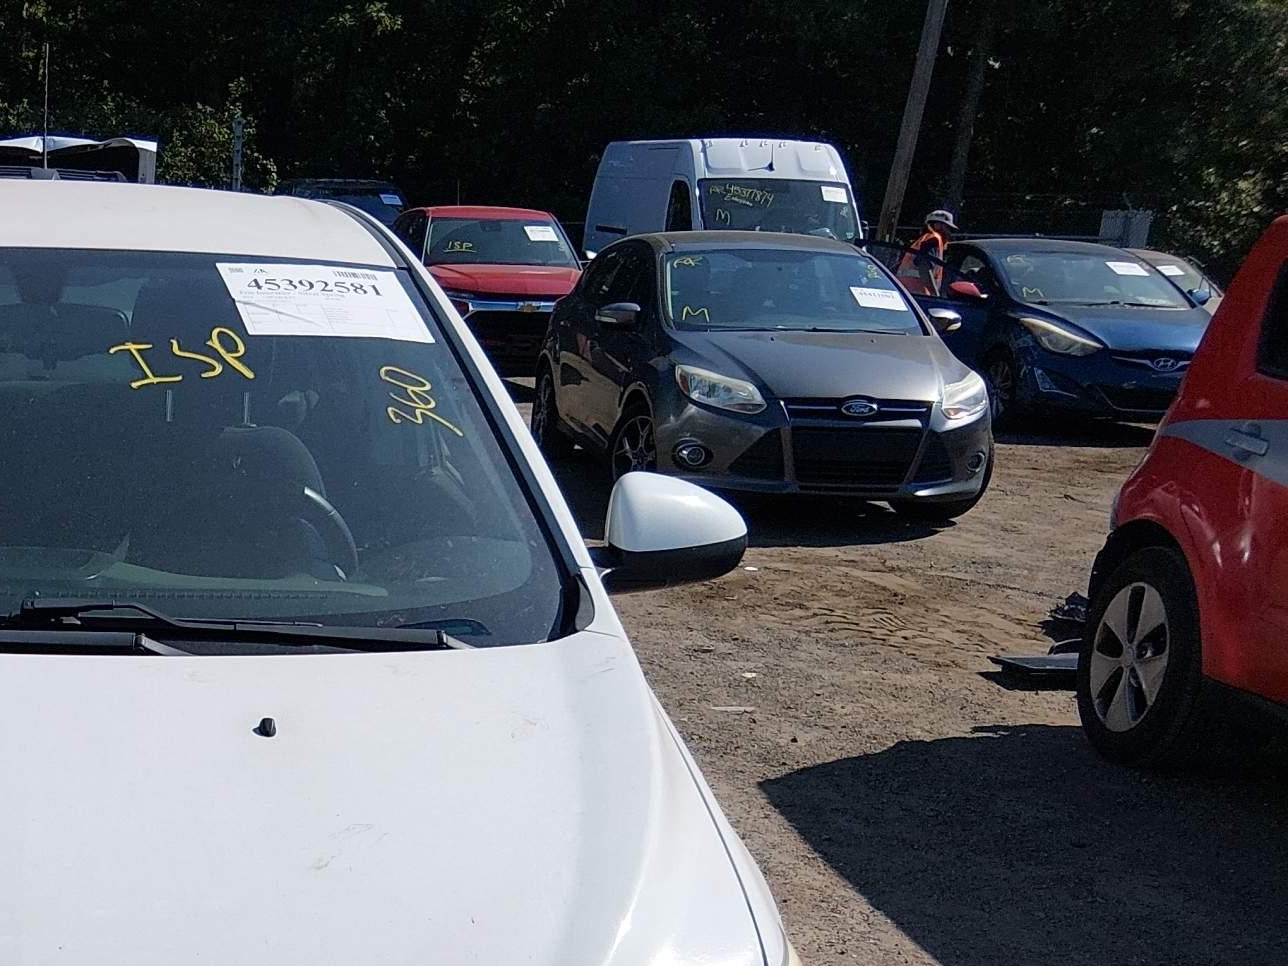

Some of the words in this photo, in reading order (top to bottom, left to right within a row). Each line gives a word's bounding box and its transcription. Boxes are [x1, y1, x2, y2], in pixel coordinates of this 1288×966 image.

[715, 208, 730, 225] M
[447, 240, 473, 250] ISP
[247, 277, 383, 297] 45392581
[1022, 286, 1045, 298] M
[681, 305, 710, 323] M
[108, 326, 256, 390] ISP
[379, 365, 464, 437] 360
